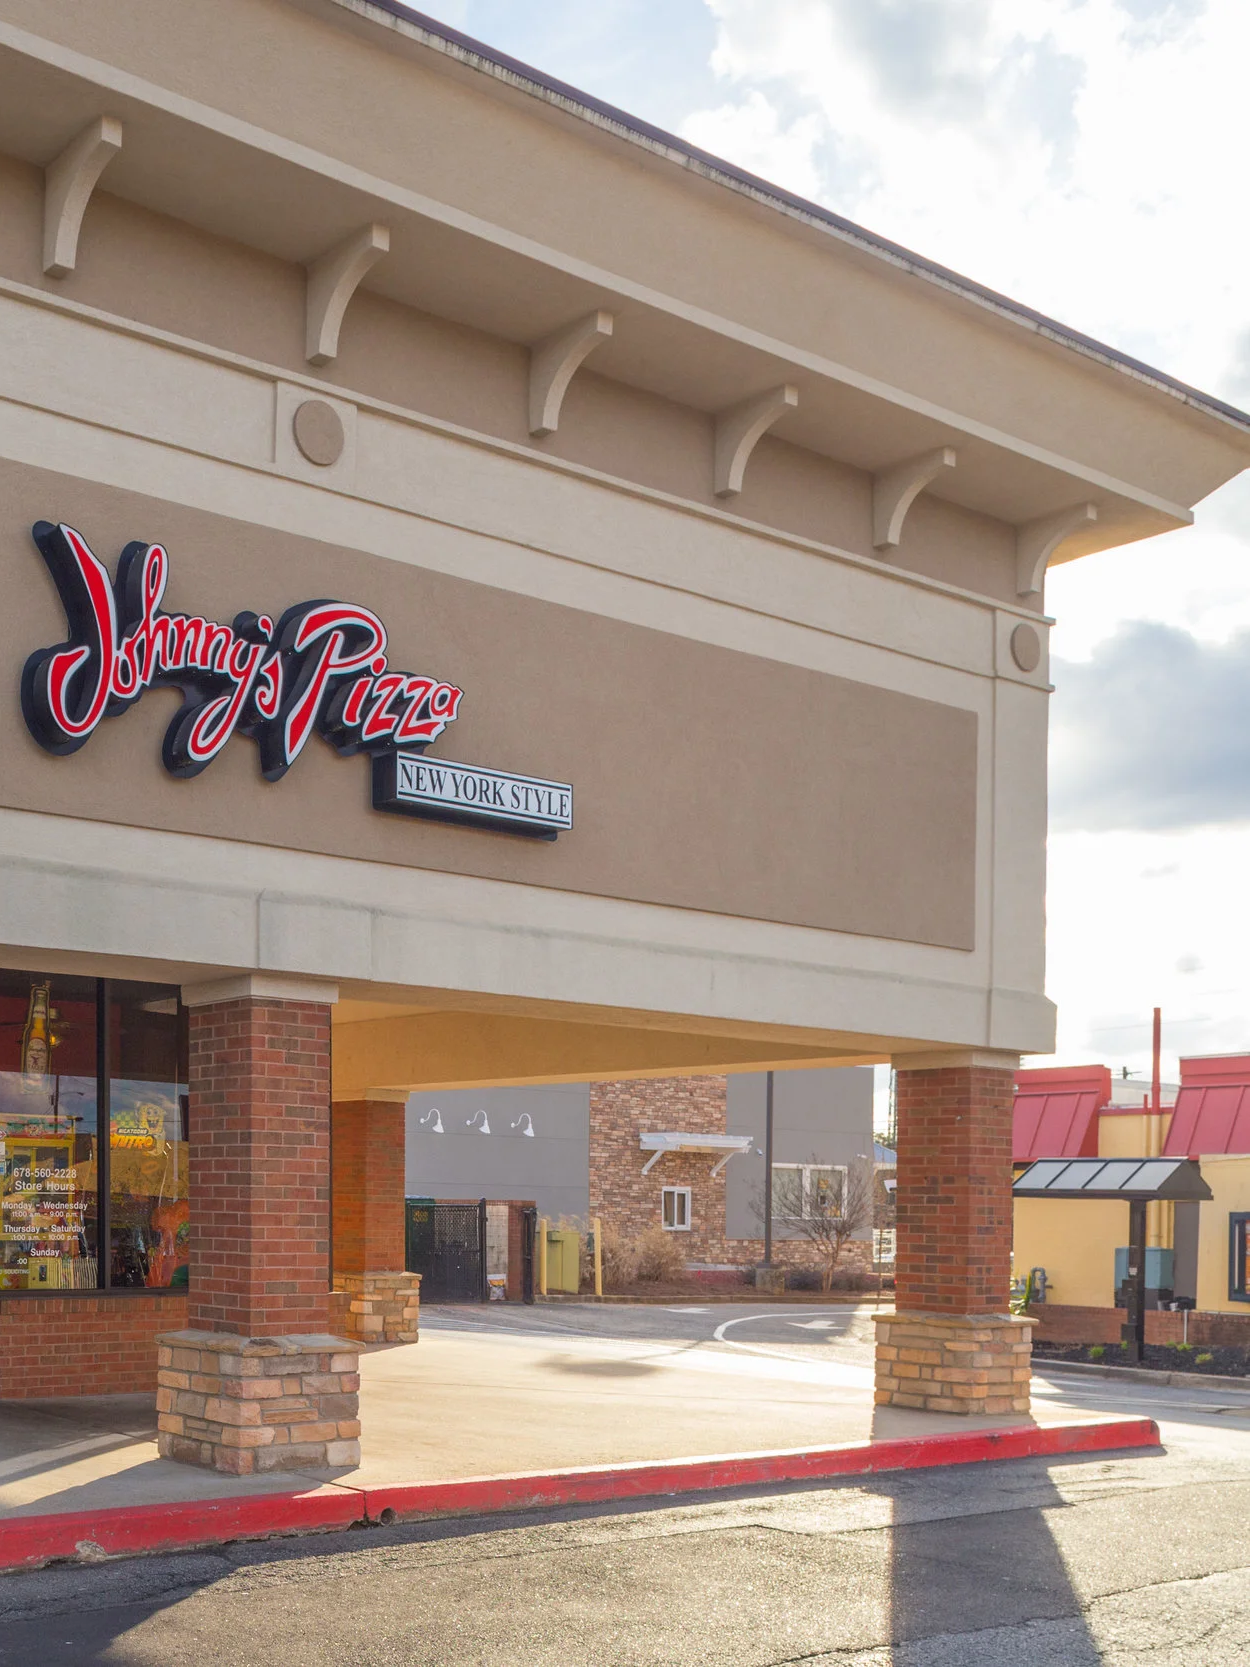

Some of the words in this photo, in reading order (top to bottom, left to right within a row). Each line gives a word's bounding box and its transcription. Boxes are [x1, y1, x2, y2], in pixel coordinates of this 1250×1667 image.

[48, 523, 283, 761] Johnny's
[285, 602, 464, 766] Pizza
[400, 763, 447, 795] NEW
[450, 772, 506, 807] YORK
[510, 784, 570, 818] STYLE
[13, 1168, 77, 1179] 678-560-2228
[15, 1181, 42, 1191] Store
[46, 1181, 75, 1191] Hours
[1, 1202, 33, 1211] Monday
[43, 1201, 88, 1211] Wednesday
[4, 1224, 40, 1233] Thursday
[51, 1224, 86, 1233] Saturday
[30, 1248, 60, 1258] Sunday
